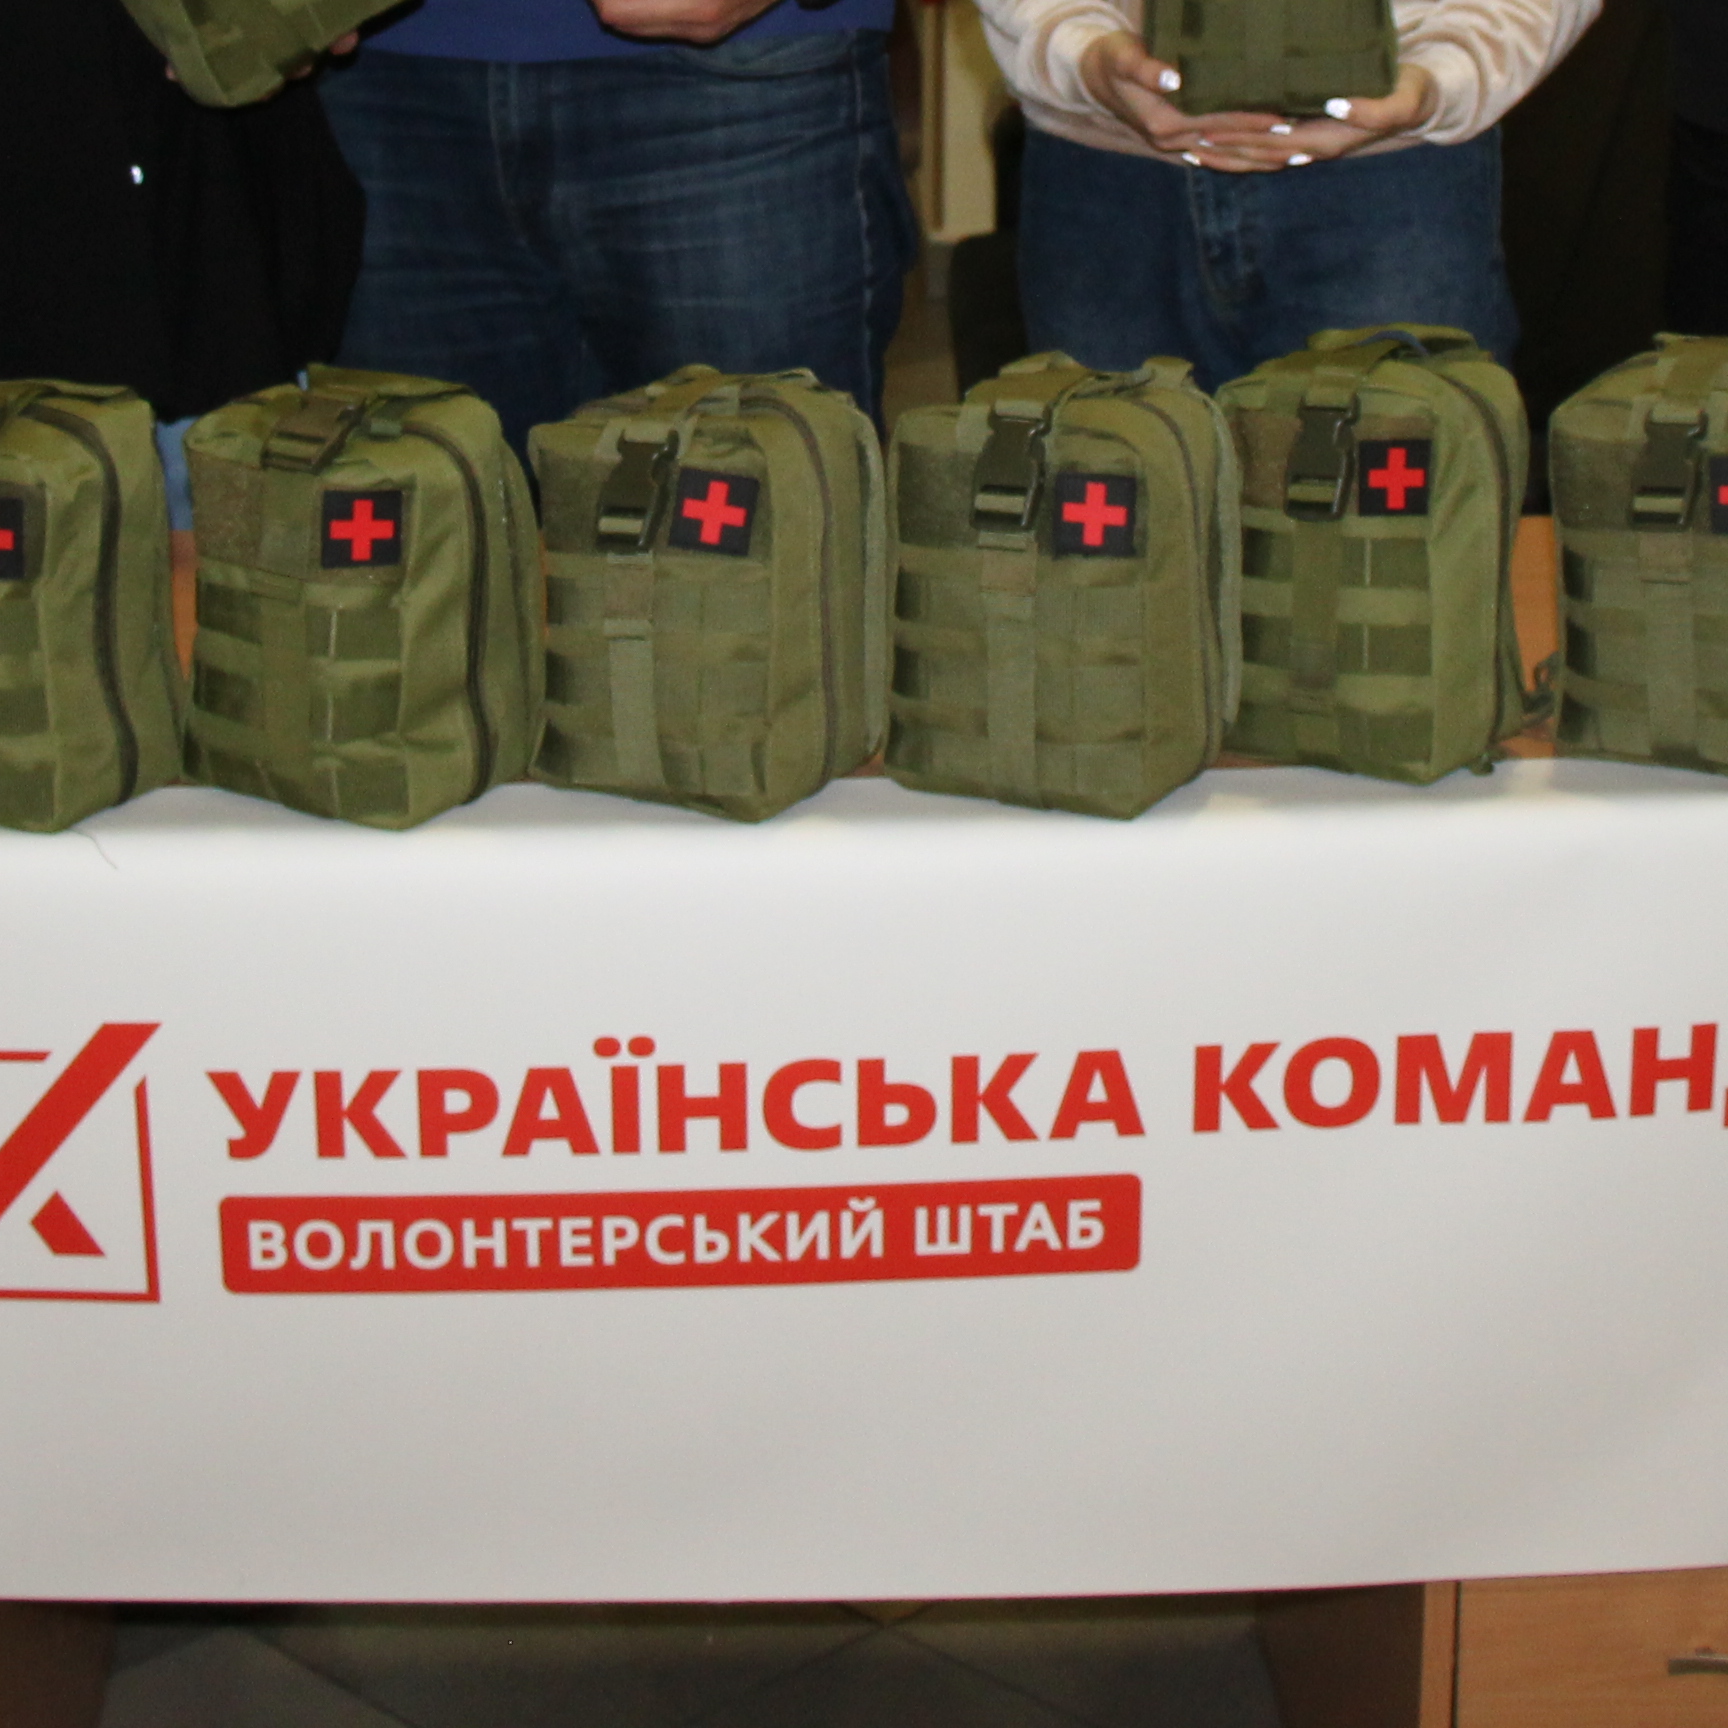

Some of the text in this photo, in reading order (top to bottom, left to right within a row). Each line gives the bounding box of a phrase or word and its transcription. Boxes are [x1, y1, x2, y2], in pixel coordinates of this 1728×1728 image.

[209, 1036, 1144, 1159] УКРАЇНСЬКА
[248, 1198, 1106, 1271] ВОЛОНТЕРСЬКИЙ ШТАБ
